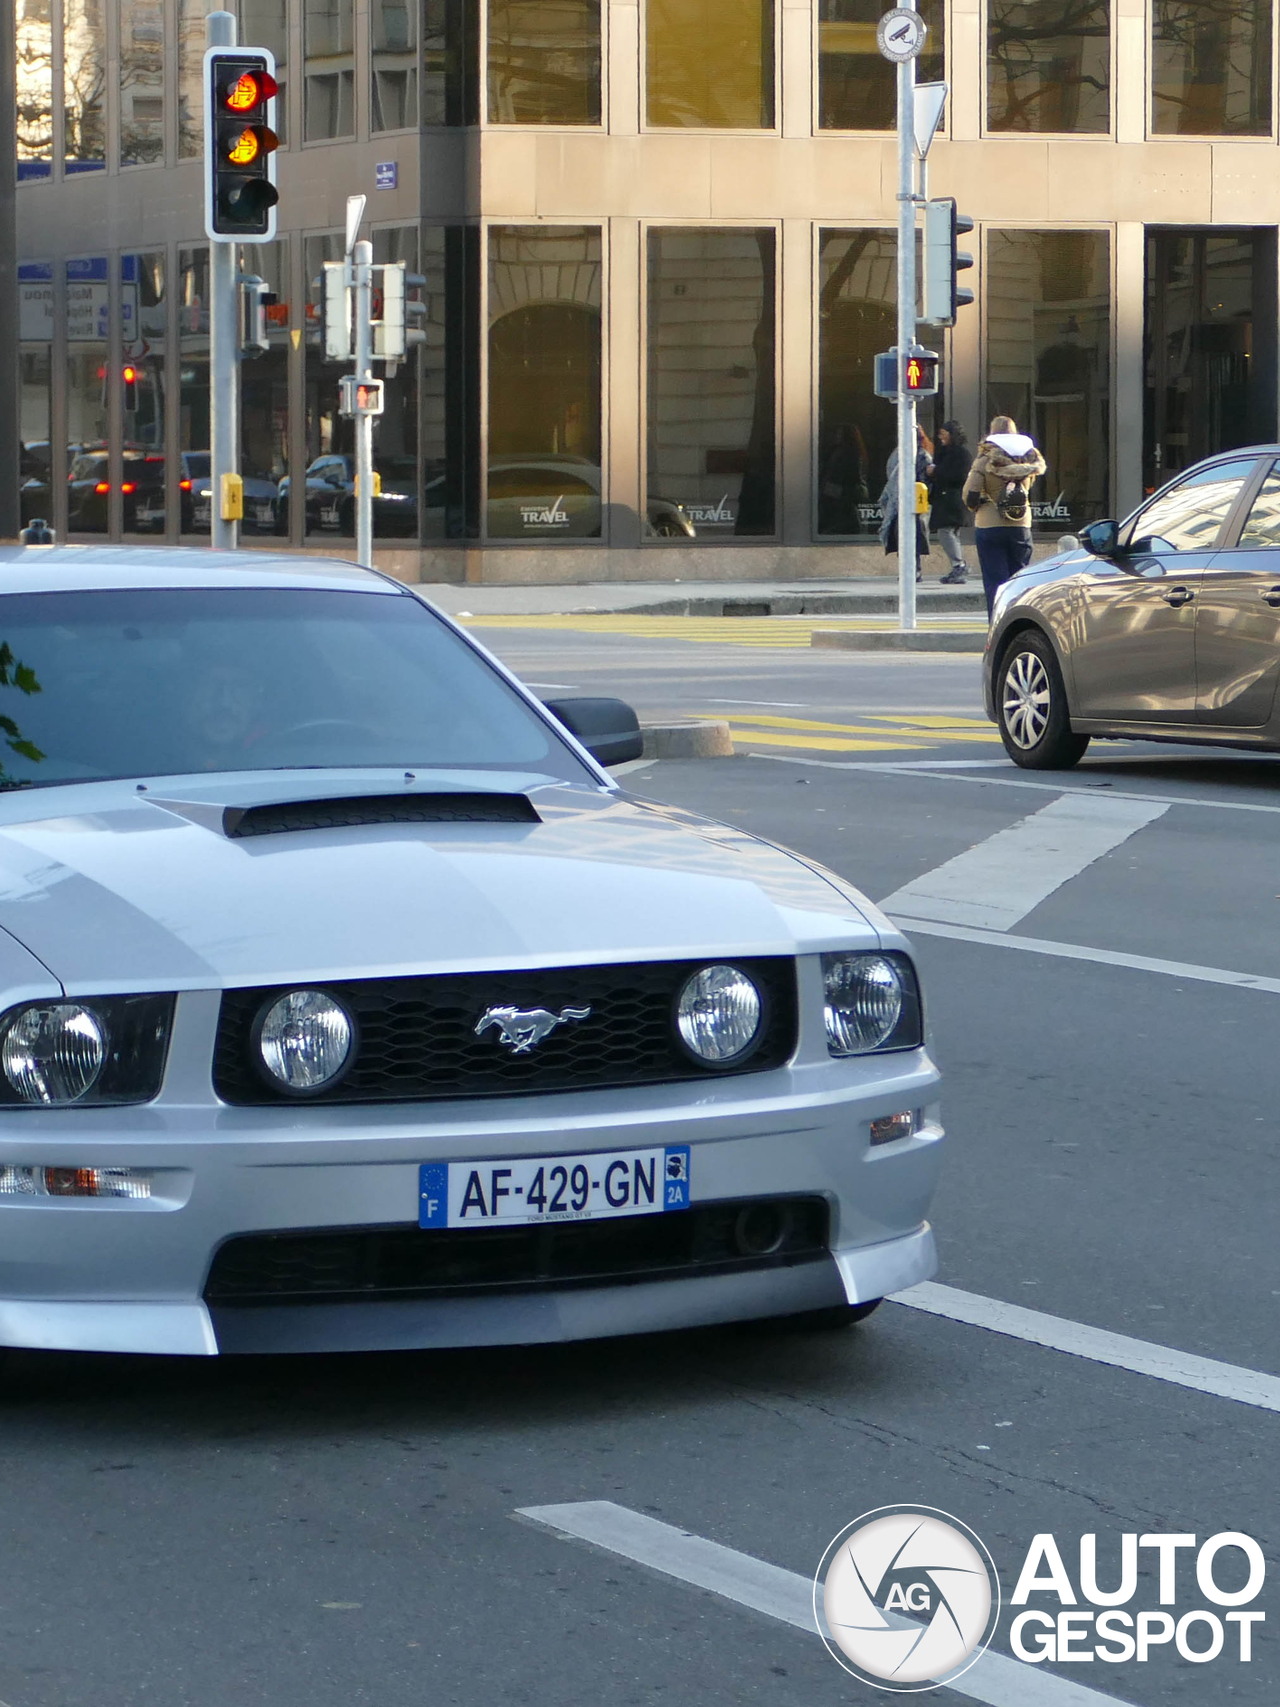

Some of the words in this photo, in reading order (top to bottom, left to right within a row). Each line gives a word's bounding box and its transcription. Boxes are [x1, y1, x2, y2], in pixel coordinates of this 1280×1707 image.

[459, 1157, 656, 1218] AF-429-GN
[667, 1186, 683, 1204] 2A
[426, 1199, 439, 1218] F
